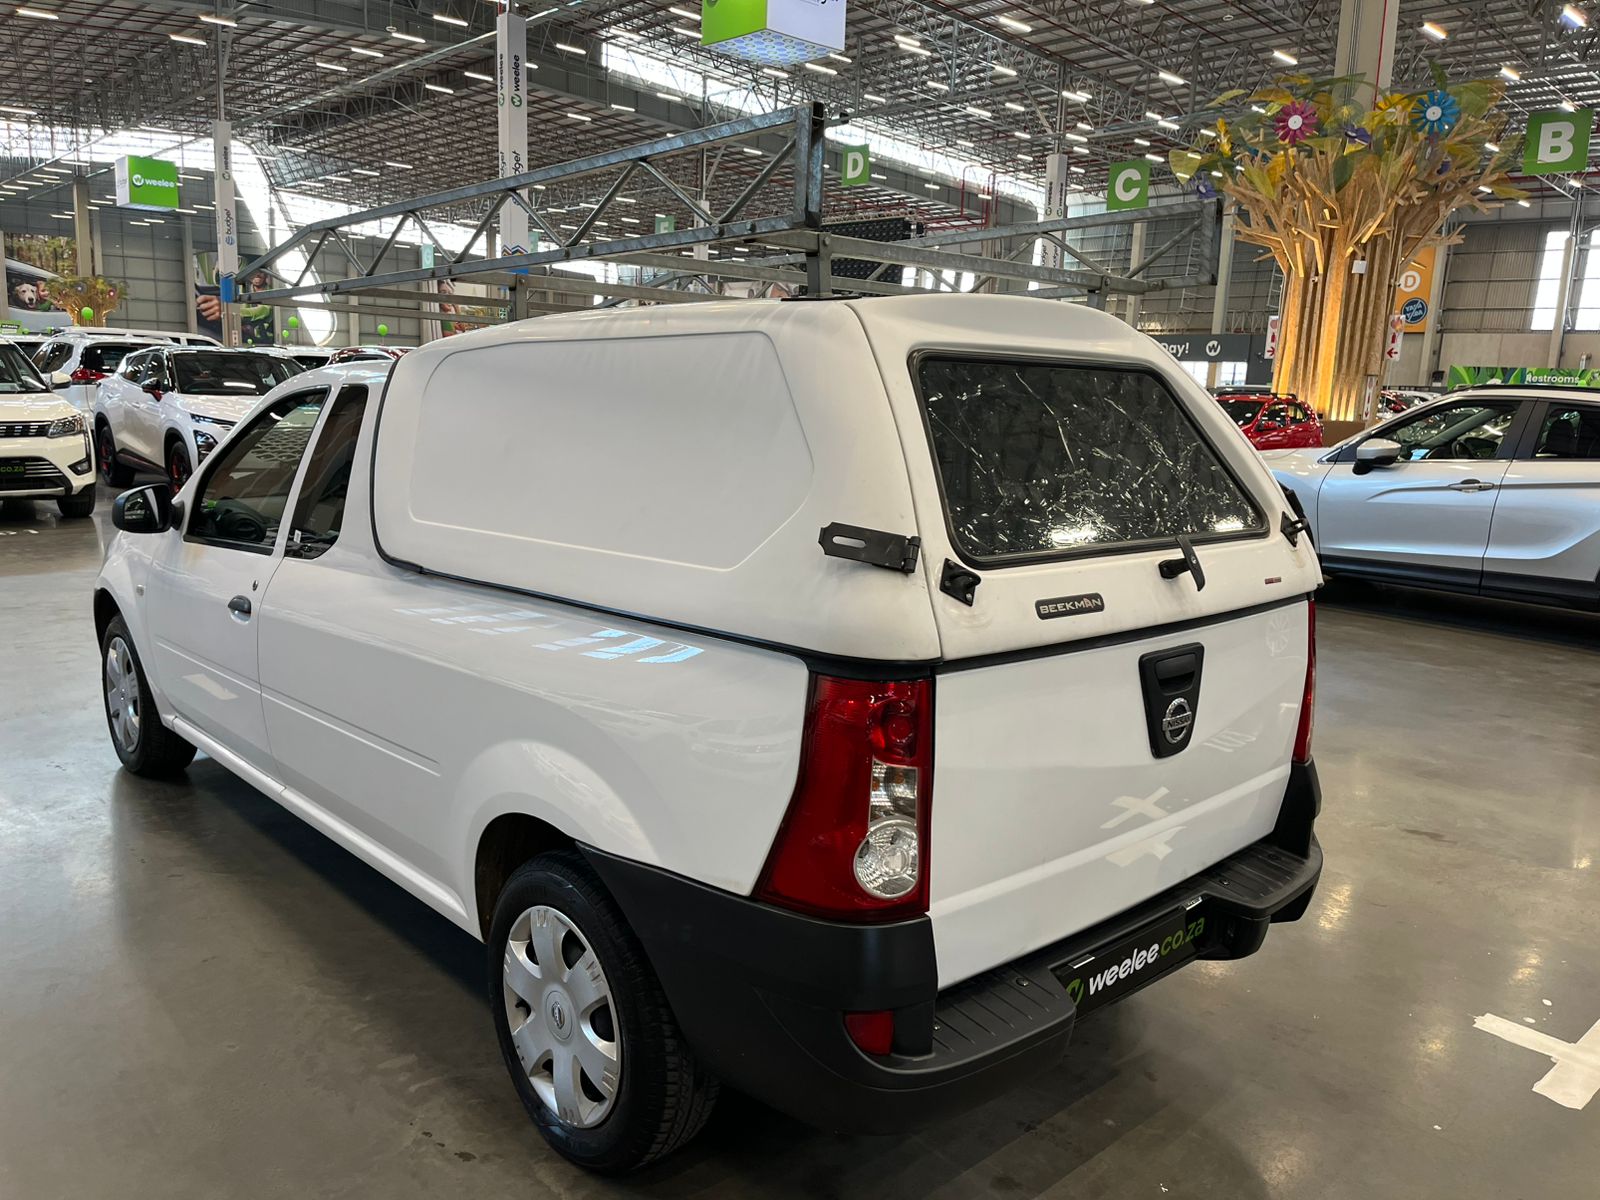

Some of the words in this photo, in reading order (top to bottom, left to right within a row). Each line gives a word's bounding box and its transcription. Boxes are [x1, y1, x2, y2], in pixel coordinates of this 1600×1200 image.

[512, 54, 520, 91] weelee
[1537, 121, 1575, 164] B
[847, 151, 864, 179] D
[145, 178, 175, 188] weelee
[1115, 168, 1141, 202] C
[1404, 275, 1417, 288] D
[1526, 373, 1580, 384] Restrooms
[1040, 597, 1102, 614] BEEKMAN
